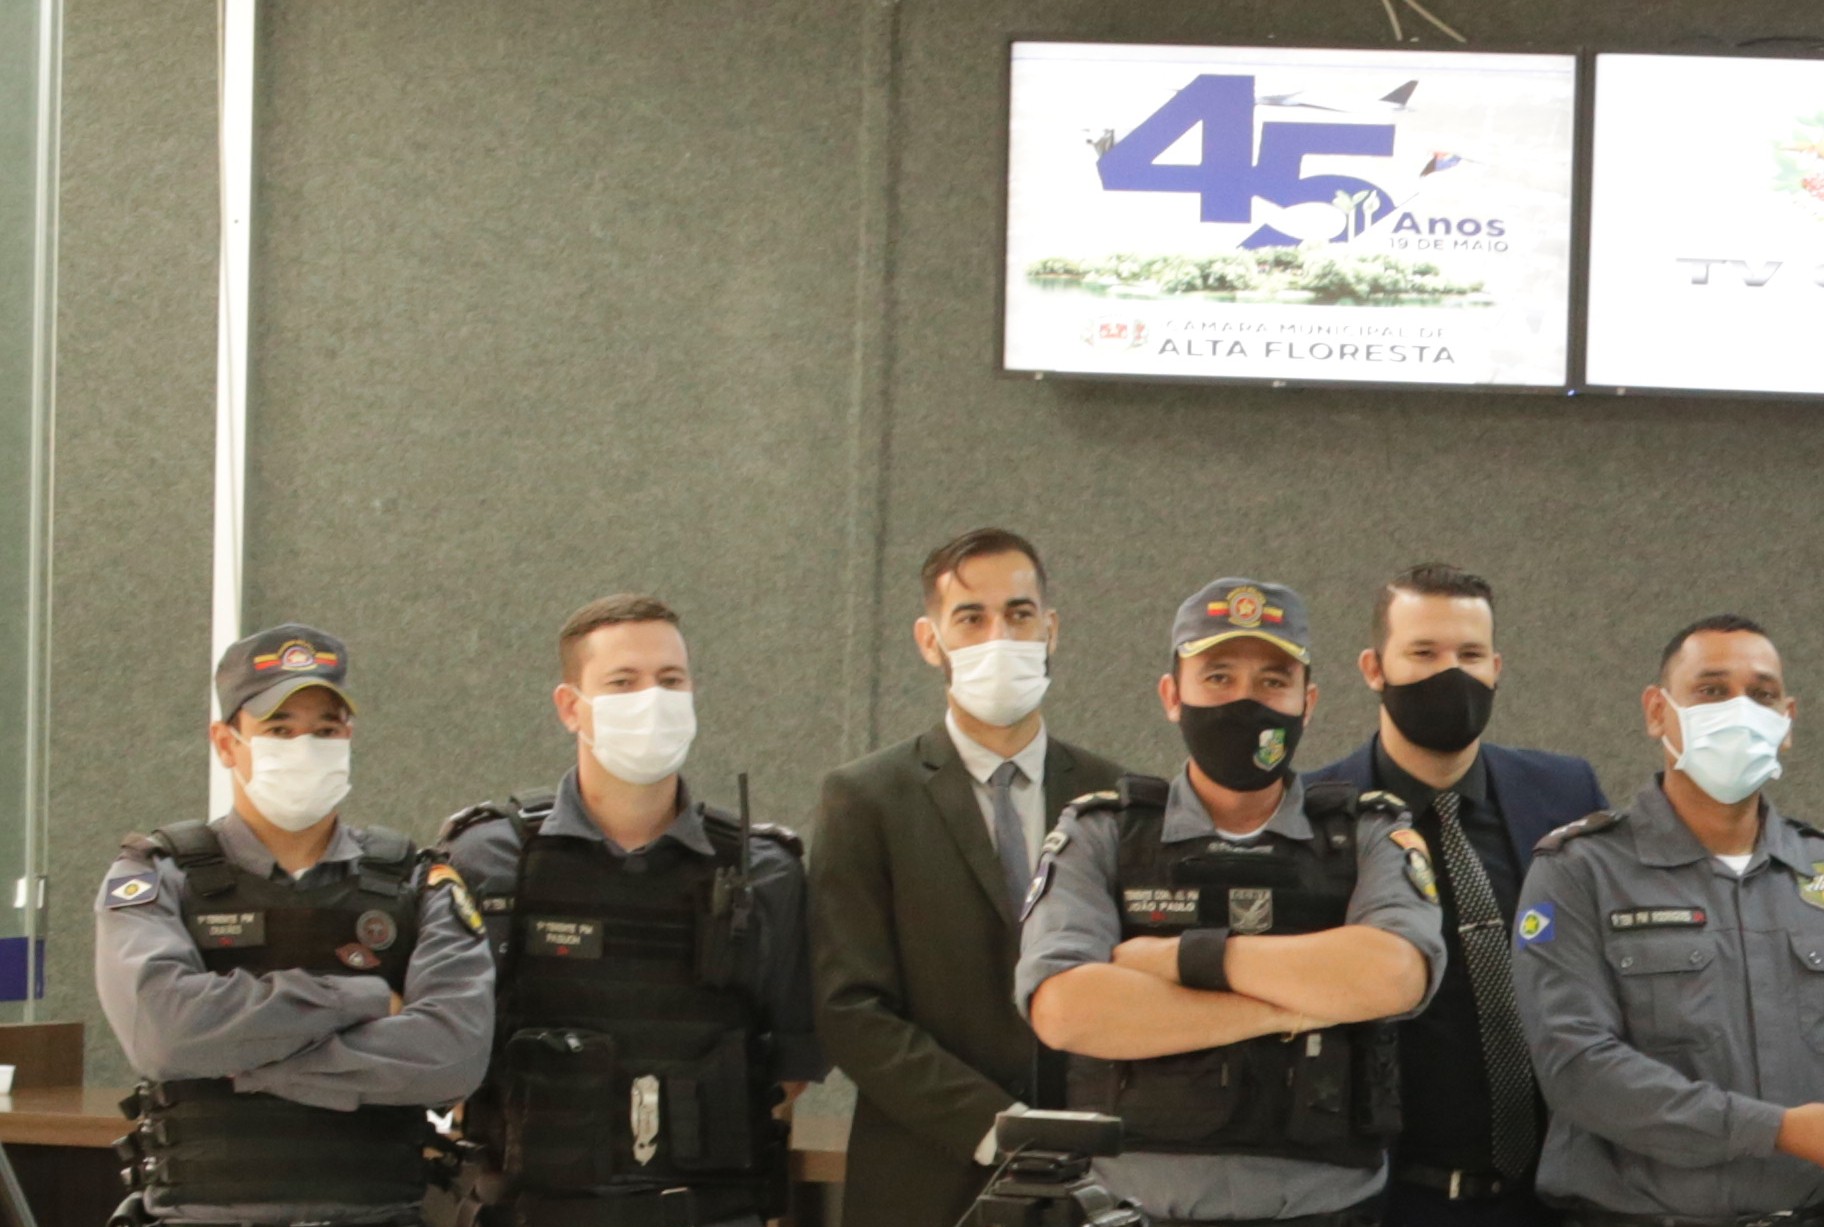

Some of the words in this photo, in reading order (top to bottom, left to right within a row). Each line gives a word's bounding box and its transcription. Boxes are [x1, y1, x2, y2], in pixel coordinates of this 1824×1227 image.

[1096, 74, 1397, 250] 45
[1391, 211, 1506, 237] Anos
[1389, 237, 1409, 250] 19
[1418, 238, 1443, 250] DE
[1453, 239, 1509, 252] MAIO
[1676, 257, 1783, 288] TV
[1158, 338, 1249, 358] ALTA
[1264, 341, 1456, 365] FLORESTA
